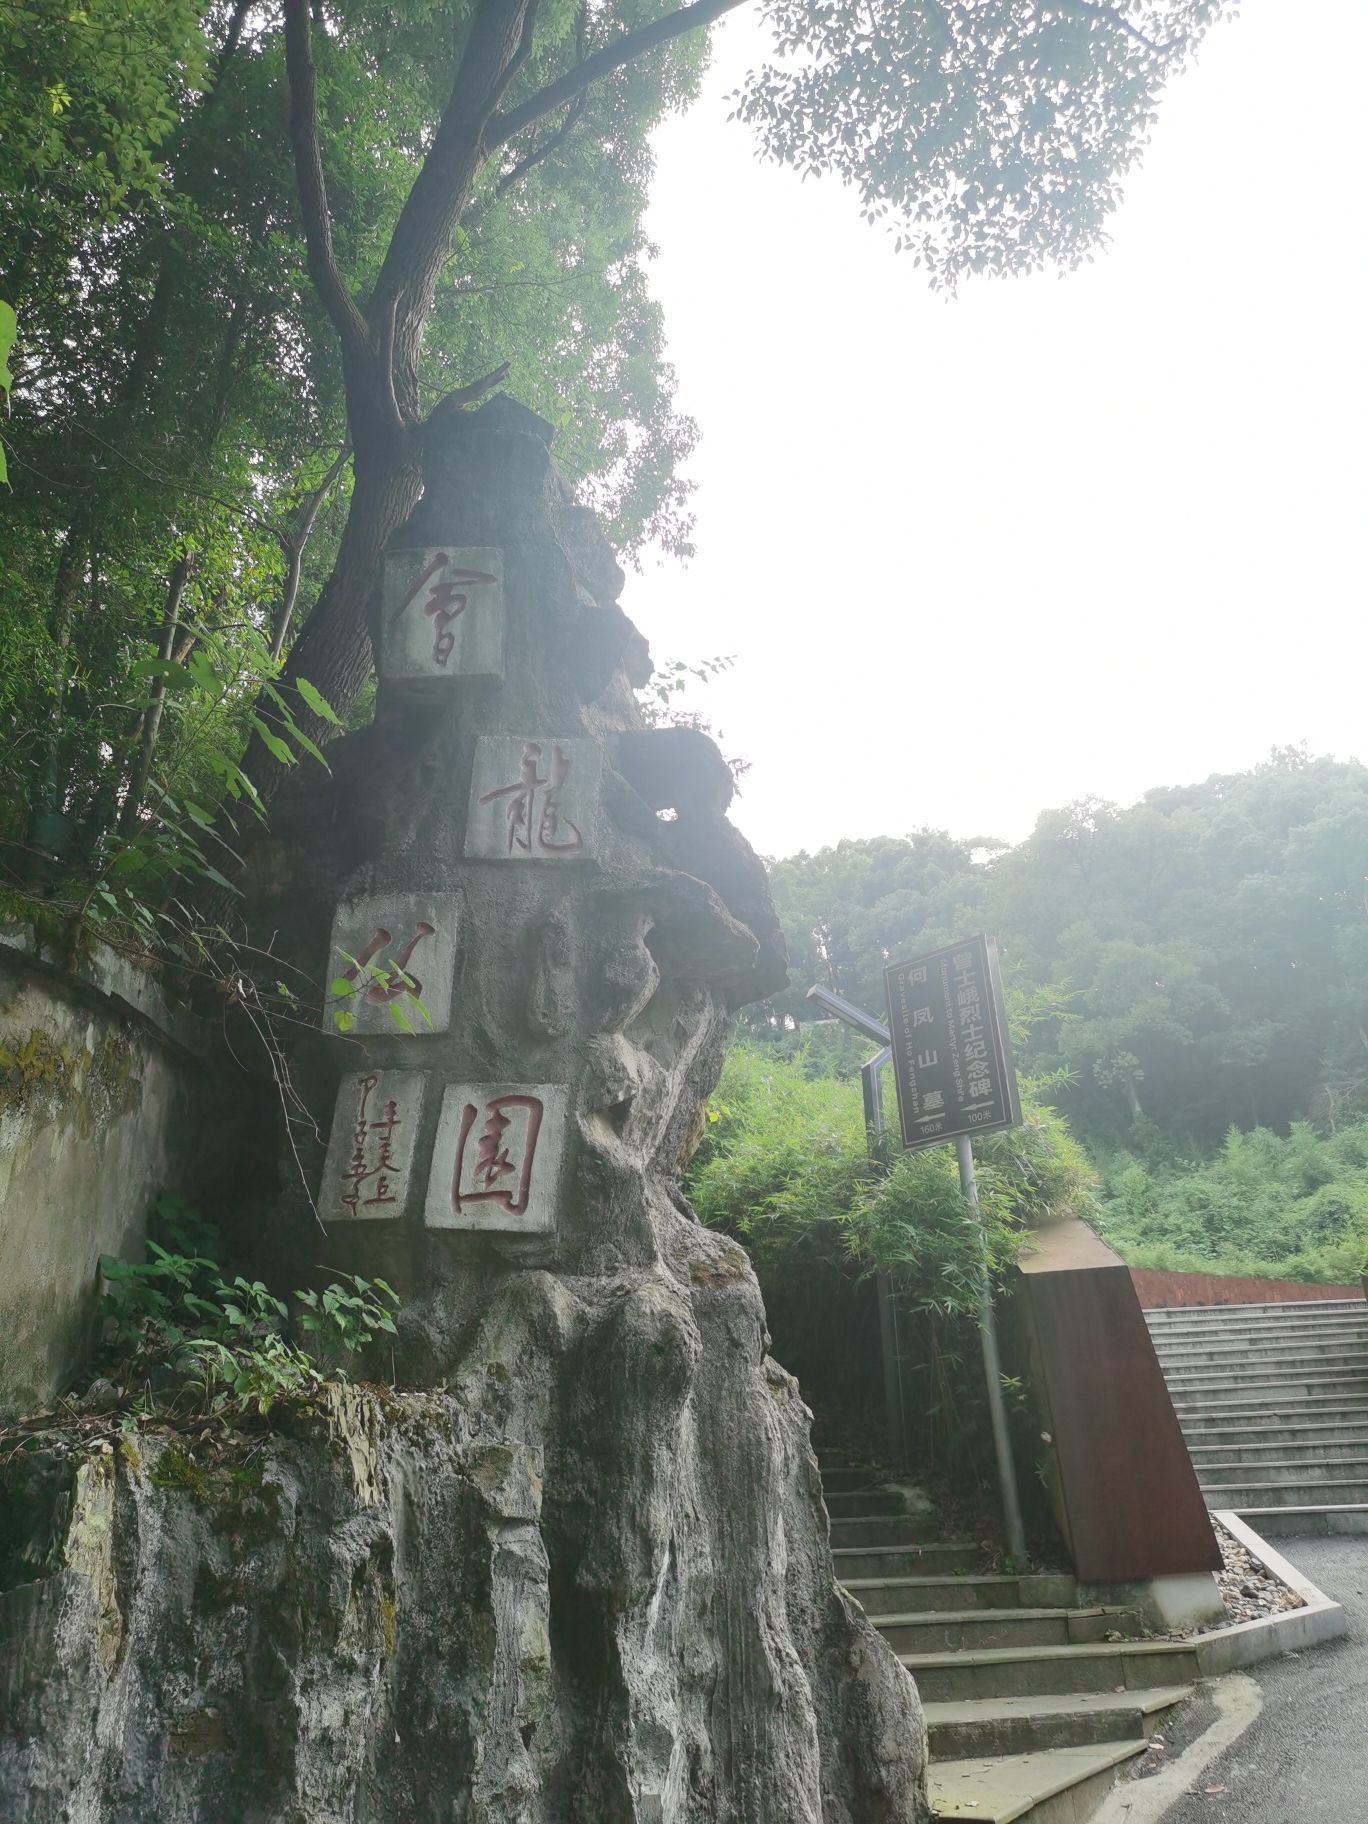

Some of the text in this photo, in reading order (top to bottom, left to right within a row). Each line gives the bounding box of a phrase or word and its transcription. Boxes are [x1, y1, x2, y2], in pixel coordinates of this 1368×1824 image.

[939, 958, 953, 1008] Monument
[906, 965, 944, 1111] 何凤山墓
[946, 1019, 958, 1050] Martyr
[951, 949, 993, 1099] 曾士峨烈士纪念碑
[950, 1051, 961, 1077] Zeng
[906, 1059, 920, 1114] Fengshan
[919, 1121, 943, 1135] 160米
[967, 1109, 992, 1124] 100米
